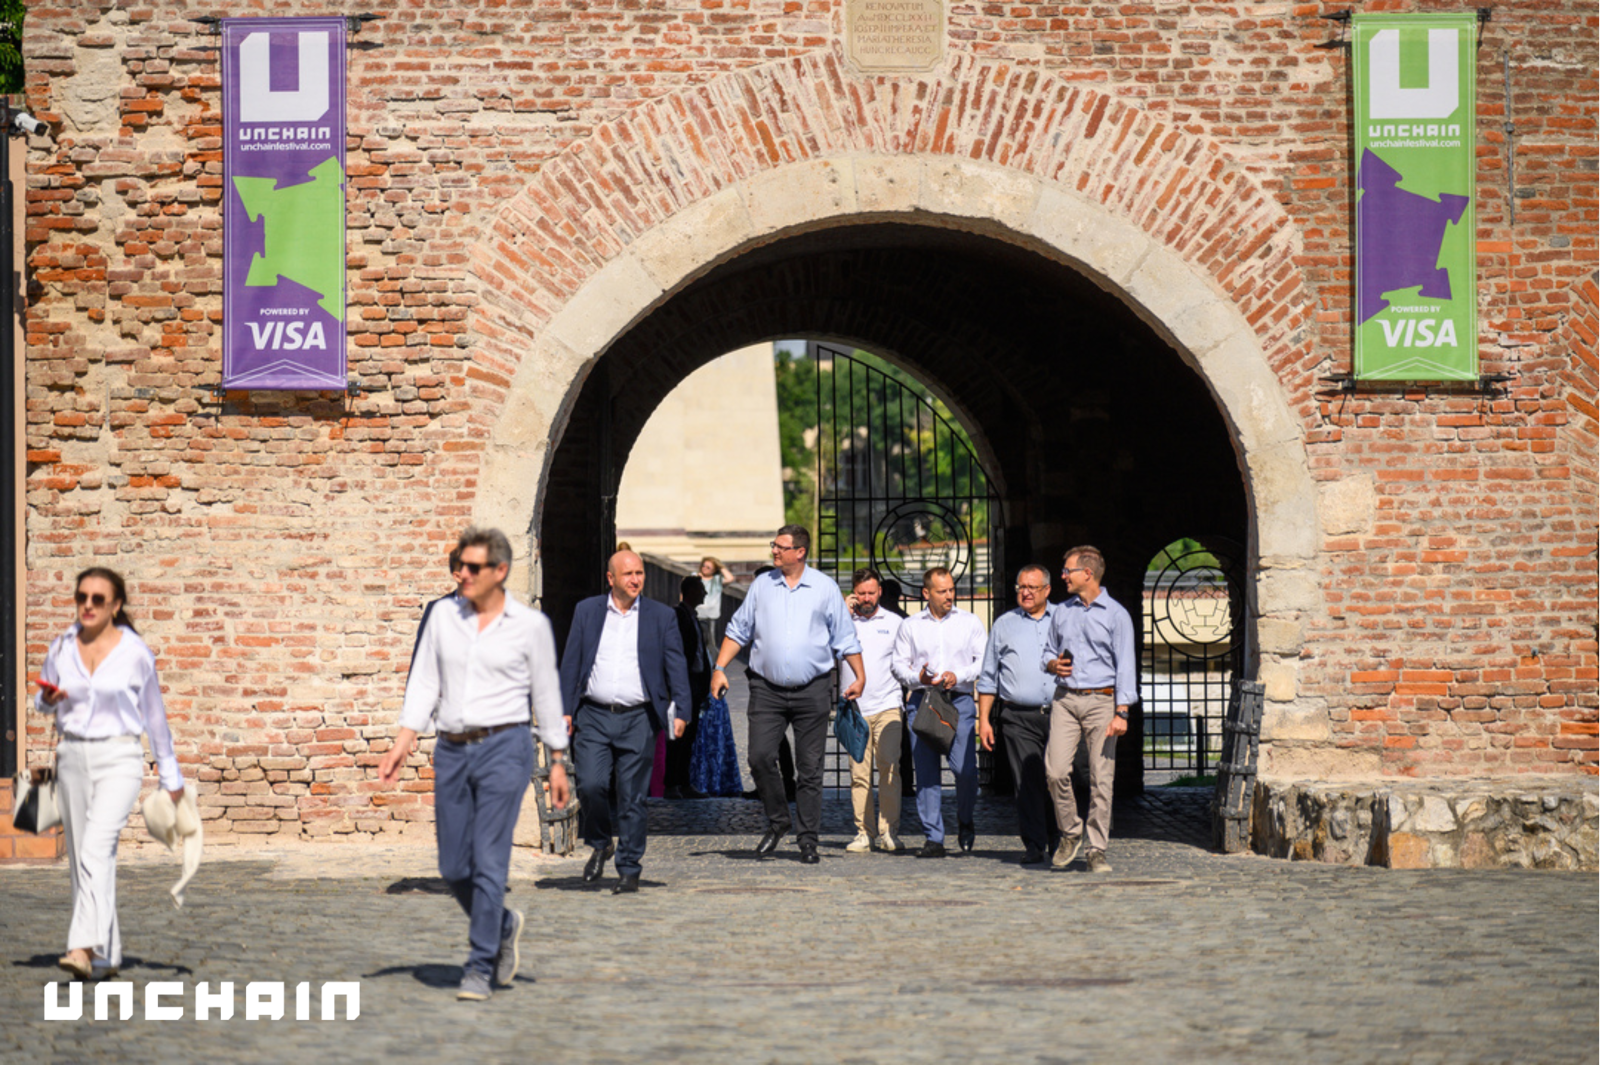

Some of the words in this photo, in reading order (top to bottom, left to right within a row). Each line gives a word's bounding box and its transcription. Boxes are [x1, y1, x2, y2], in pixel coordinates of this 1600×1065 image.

[240, 31, 329, 122] U
[1369, 28, 1459, 119] U
[239, 127, 331, 140] UNCHAIN
[1368, 124, 1460, 137] UNCHAIN
[240, 141, 331, 151] unchainfestival.com
[1370, 138, 1461, 148] unchainfestival.com
[260, 308, 298, 316] POWERED
[299, 308, 310, 316] BY
[1391, 305, 1429, 313] POWERED
[1430, 305, 1441, 313] BY
[244, 321, 327, 350] VISA
[1374, 318, 1458, 347] VISA
